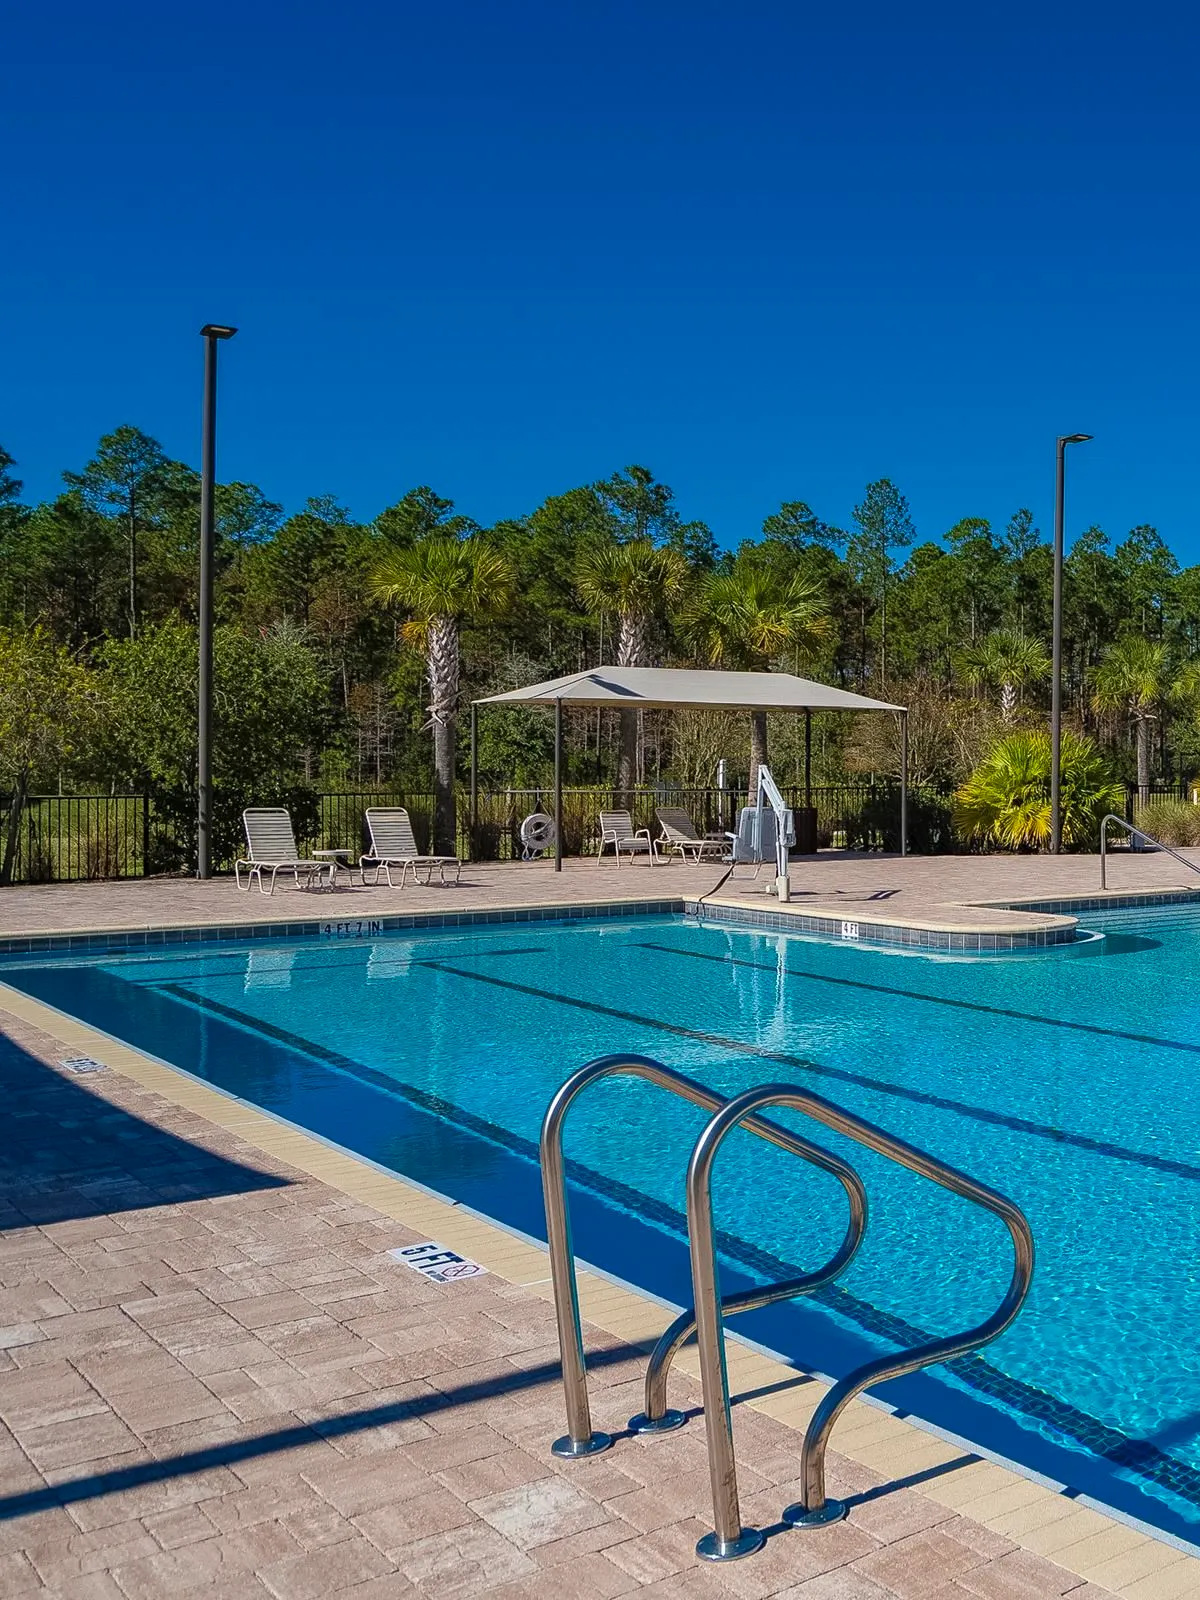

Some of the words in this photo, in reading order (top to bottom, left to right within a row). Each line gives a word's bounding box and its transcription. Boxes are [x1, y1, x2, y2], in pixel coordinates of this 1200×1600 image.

[324, 924, 331, 934] 4
[356, 922, 362, 932] 7
[844, 922, 848, 933] 4
[401, 1245, 438, 1255] 5
[408, 1251, 466, 1269] FT
